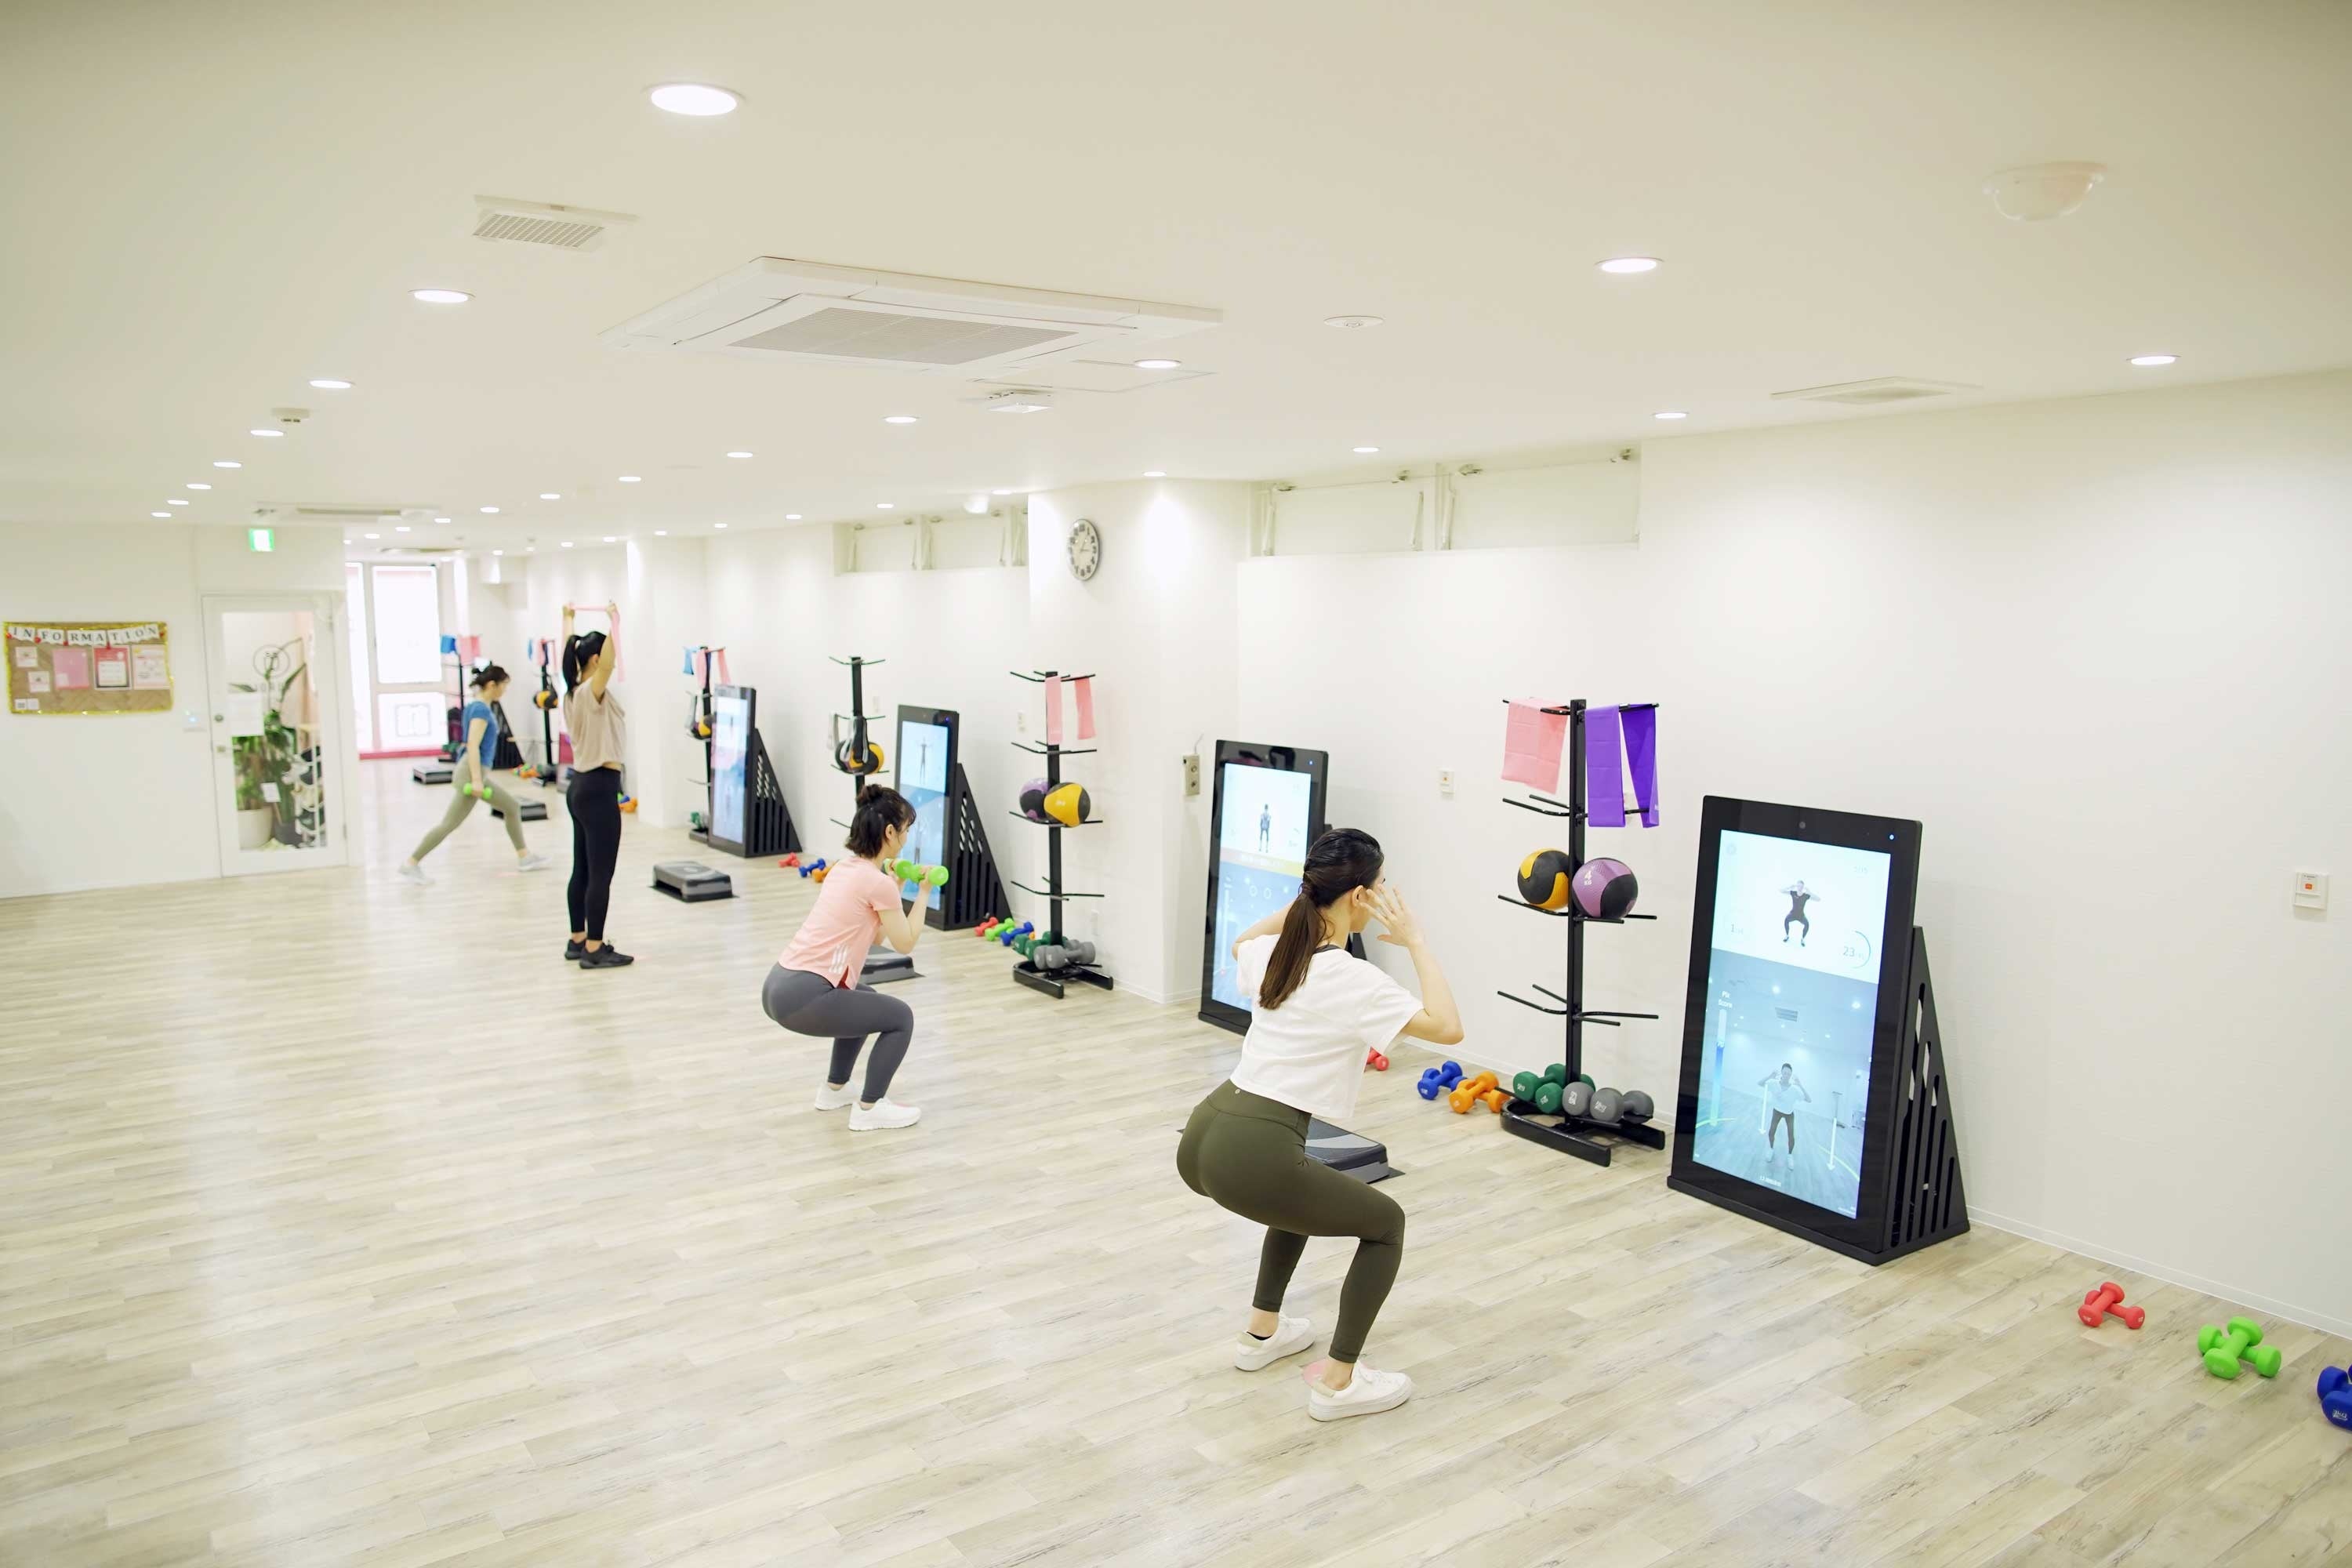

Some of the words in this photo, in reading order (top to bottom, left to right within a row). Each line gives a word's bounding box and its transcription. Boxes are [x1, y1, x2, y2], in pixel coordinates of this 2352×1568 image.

[13, 627, 158, 642] INFORMATION
[1584, 870, 1592, 880] 4
[1842, 946, 1856, 957] 23
